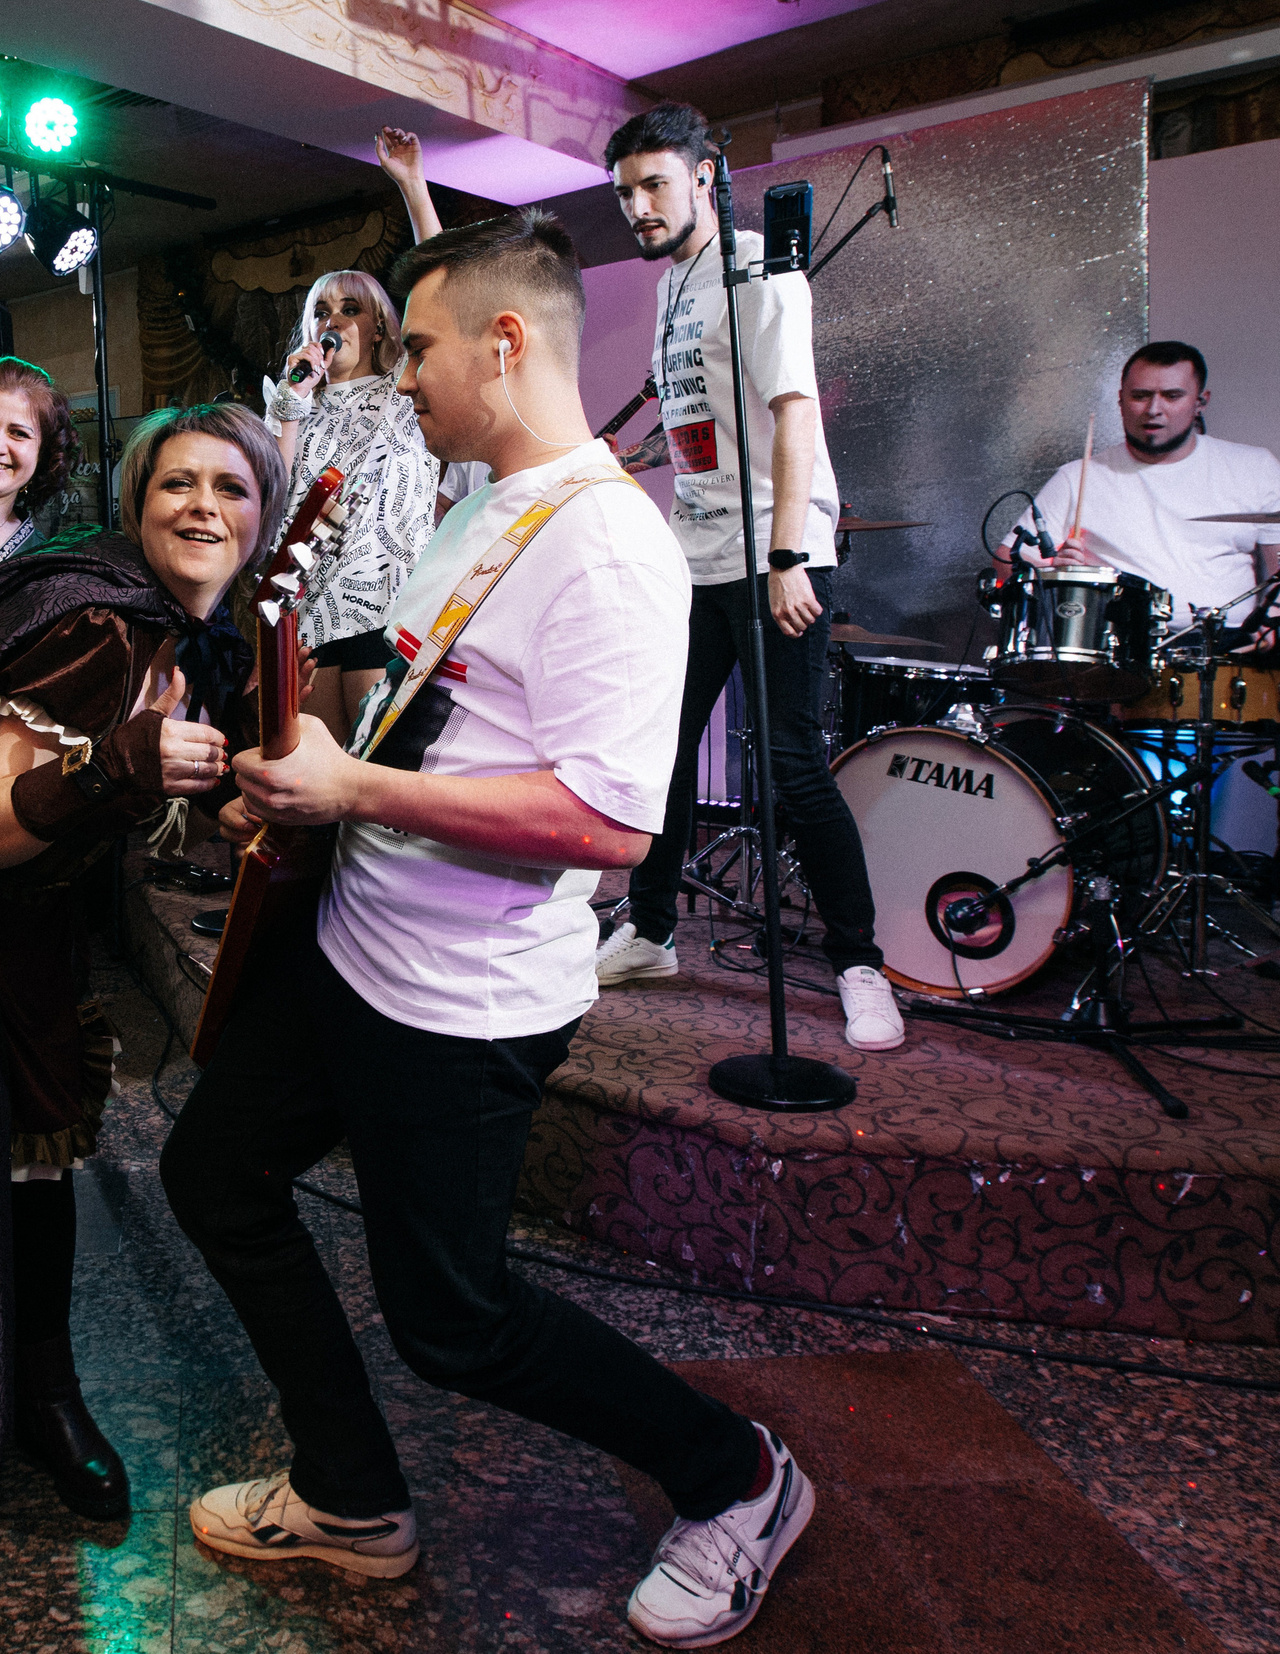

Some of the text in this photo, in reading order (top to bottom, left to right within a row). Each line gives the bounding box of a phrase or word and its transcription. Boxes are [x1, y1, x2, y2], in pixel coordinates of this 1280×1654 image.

[664, 347, 705, 374] URFING
[302, 431, 316, 462] TERROR
[71, 461, 101, 476] сех
[711, 473, 736, 485] EVERY
[390, 461, 410, 518] MONSTERS
[377, 488, 390, 522] TERROR
[374, 524, 416, 564] MONSTERS
[339, 576, 387, 592] MONSTERS
[470, 563, 499, 581] Fender
[907, 756, 995, 800] TAMA
